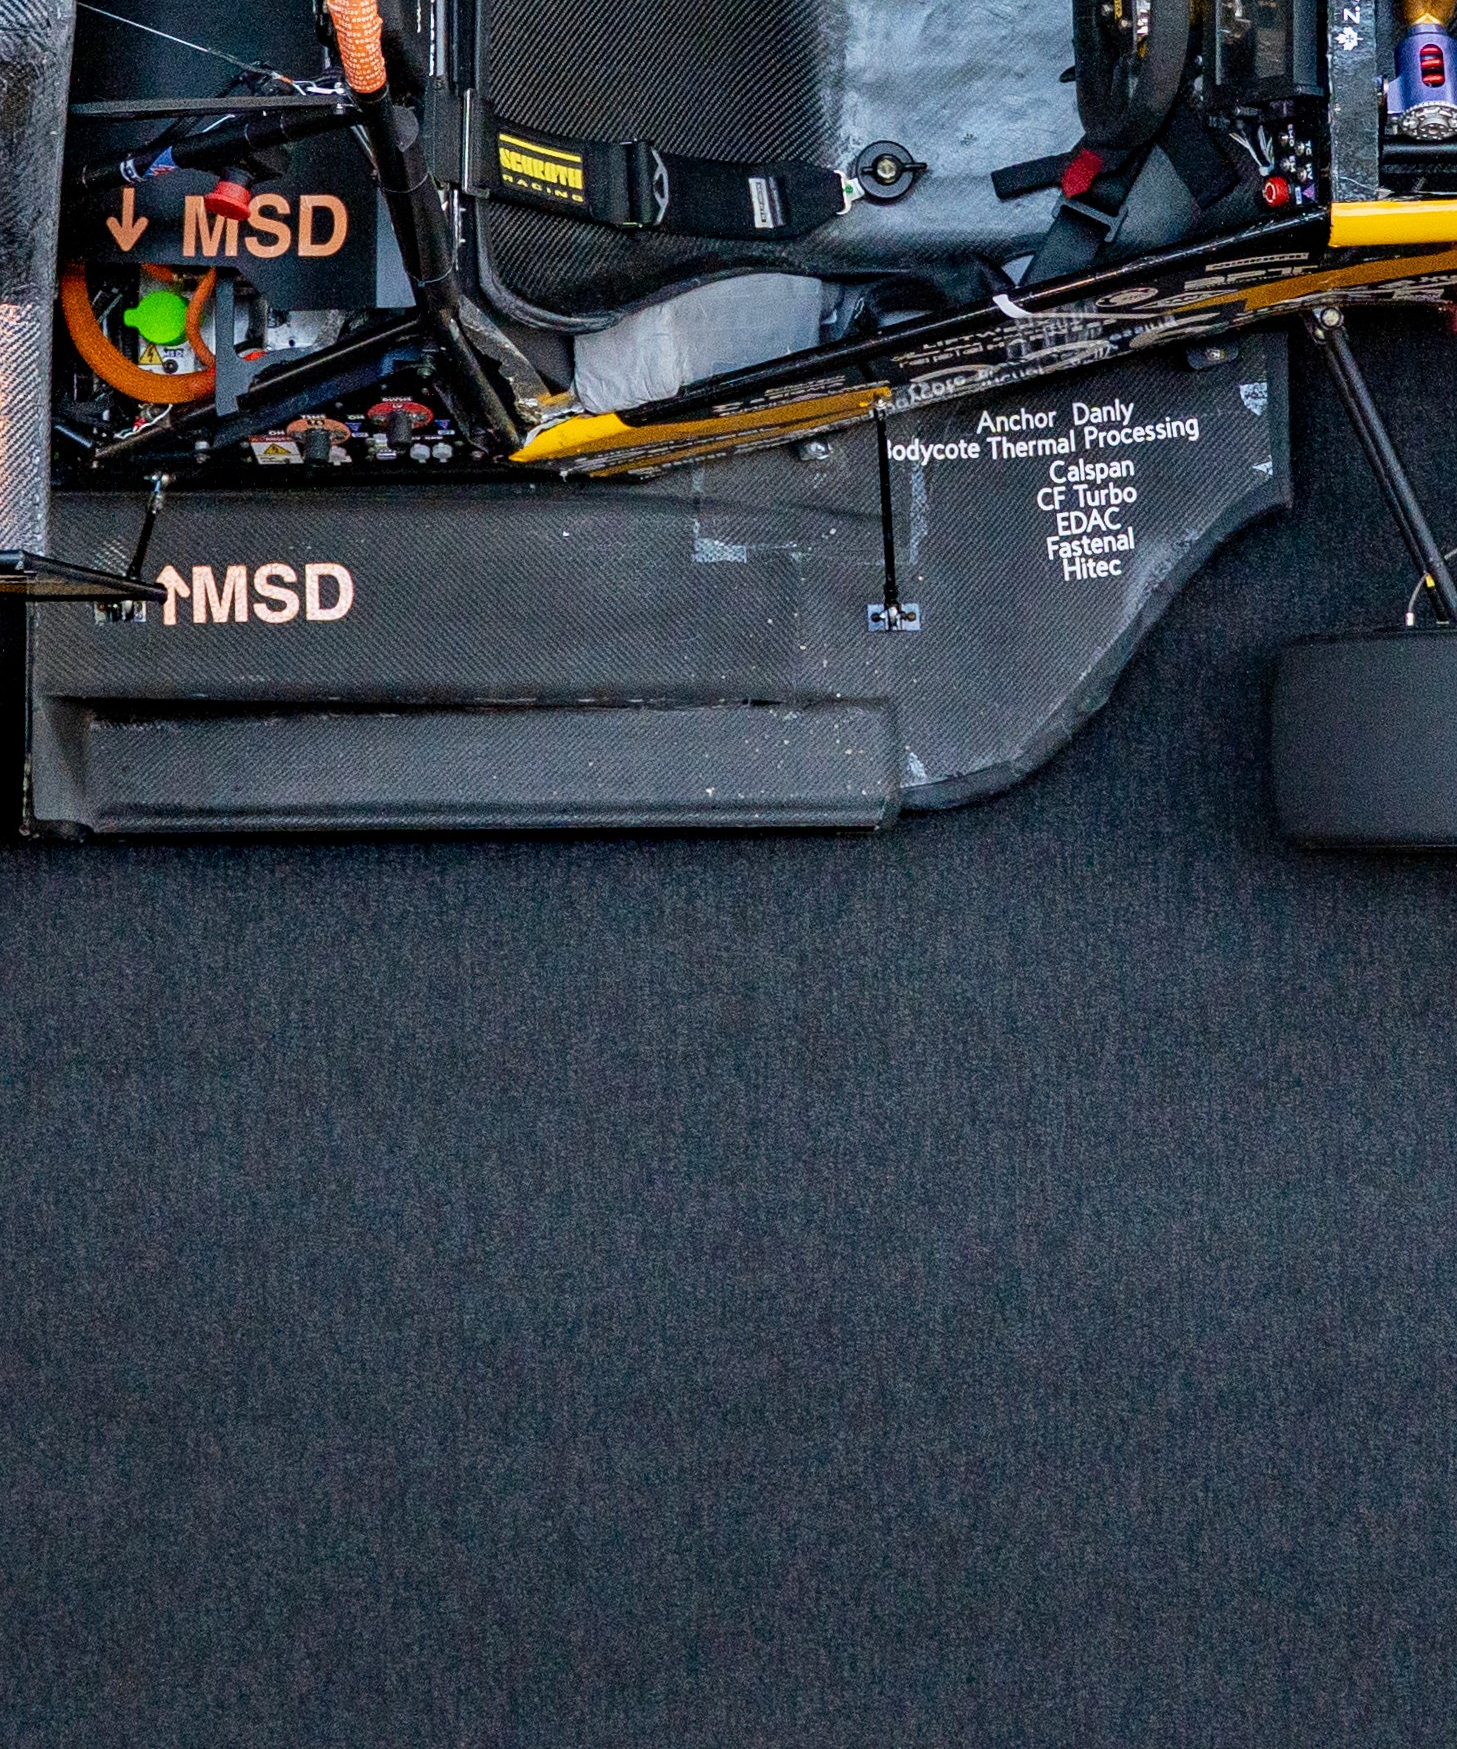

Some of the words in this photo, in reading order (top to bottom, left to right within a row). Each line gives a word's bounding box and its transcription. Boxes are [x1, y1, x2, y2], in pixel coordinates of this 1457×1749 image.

[499, 146, 584, 190] SCHROTH
[502, 173, 584, 204] RACING
[181, 193, 349, 258] MSD
[975, 408, 1057, 434] Anchor
[1072, 398, 1135, 429] Danly
[986, 430, 1075, 460] Thermal
[1084, 417, 1200, 450] Processing
[1049, 459, 1135, 485] Calspan
[1037, 486, 1066, 511] CF
[1072, 483, 1138, 507] Turbo
[1056, 507, 1122, 537] EDAC
[1047, 527, 1135, 560] Fastenal
[1063, 556, 1122, 581] Hitec
[193, 563, 355, 625] MSD
